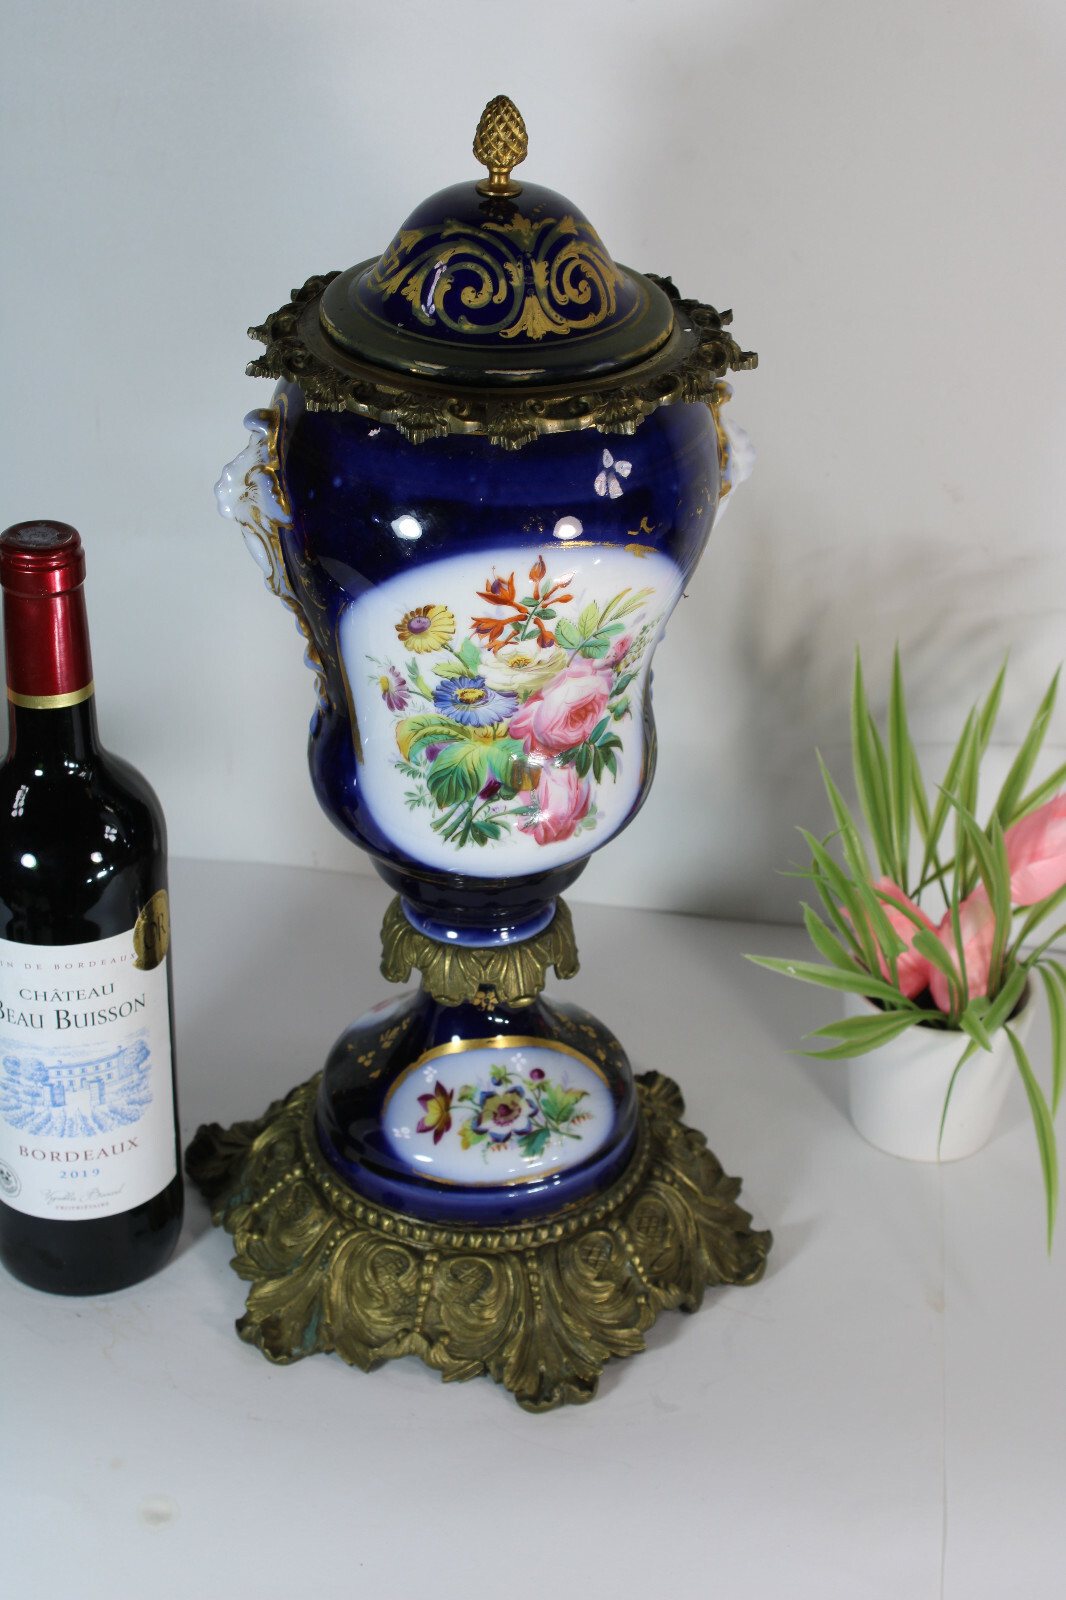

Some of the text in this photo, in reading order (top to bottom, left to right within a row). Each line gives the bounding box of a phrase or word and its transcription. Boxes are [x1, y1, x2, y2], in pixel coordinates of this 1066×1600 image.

[54, 953, 136, 970] BORDEAUX
[19, 982, 115, 1002] CHÂTEAU
[55, 992, 146, 1029] BUISSON
[19, 1137, 139, 1162] BORDEAUX
[59, 1168, 101, 1179] 2019
